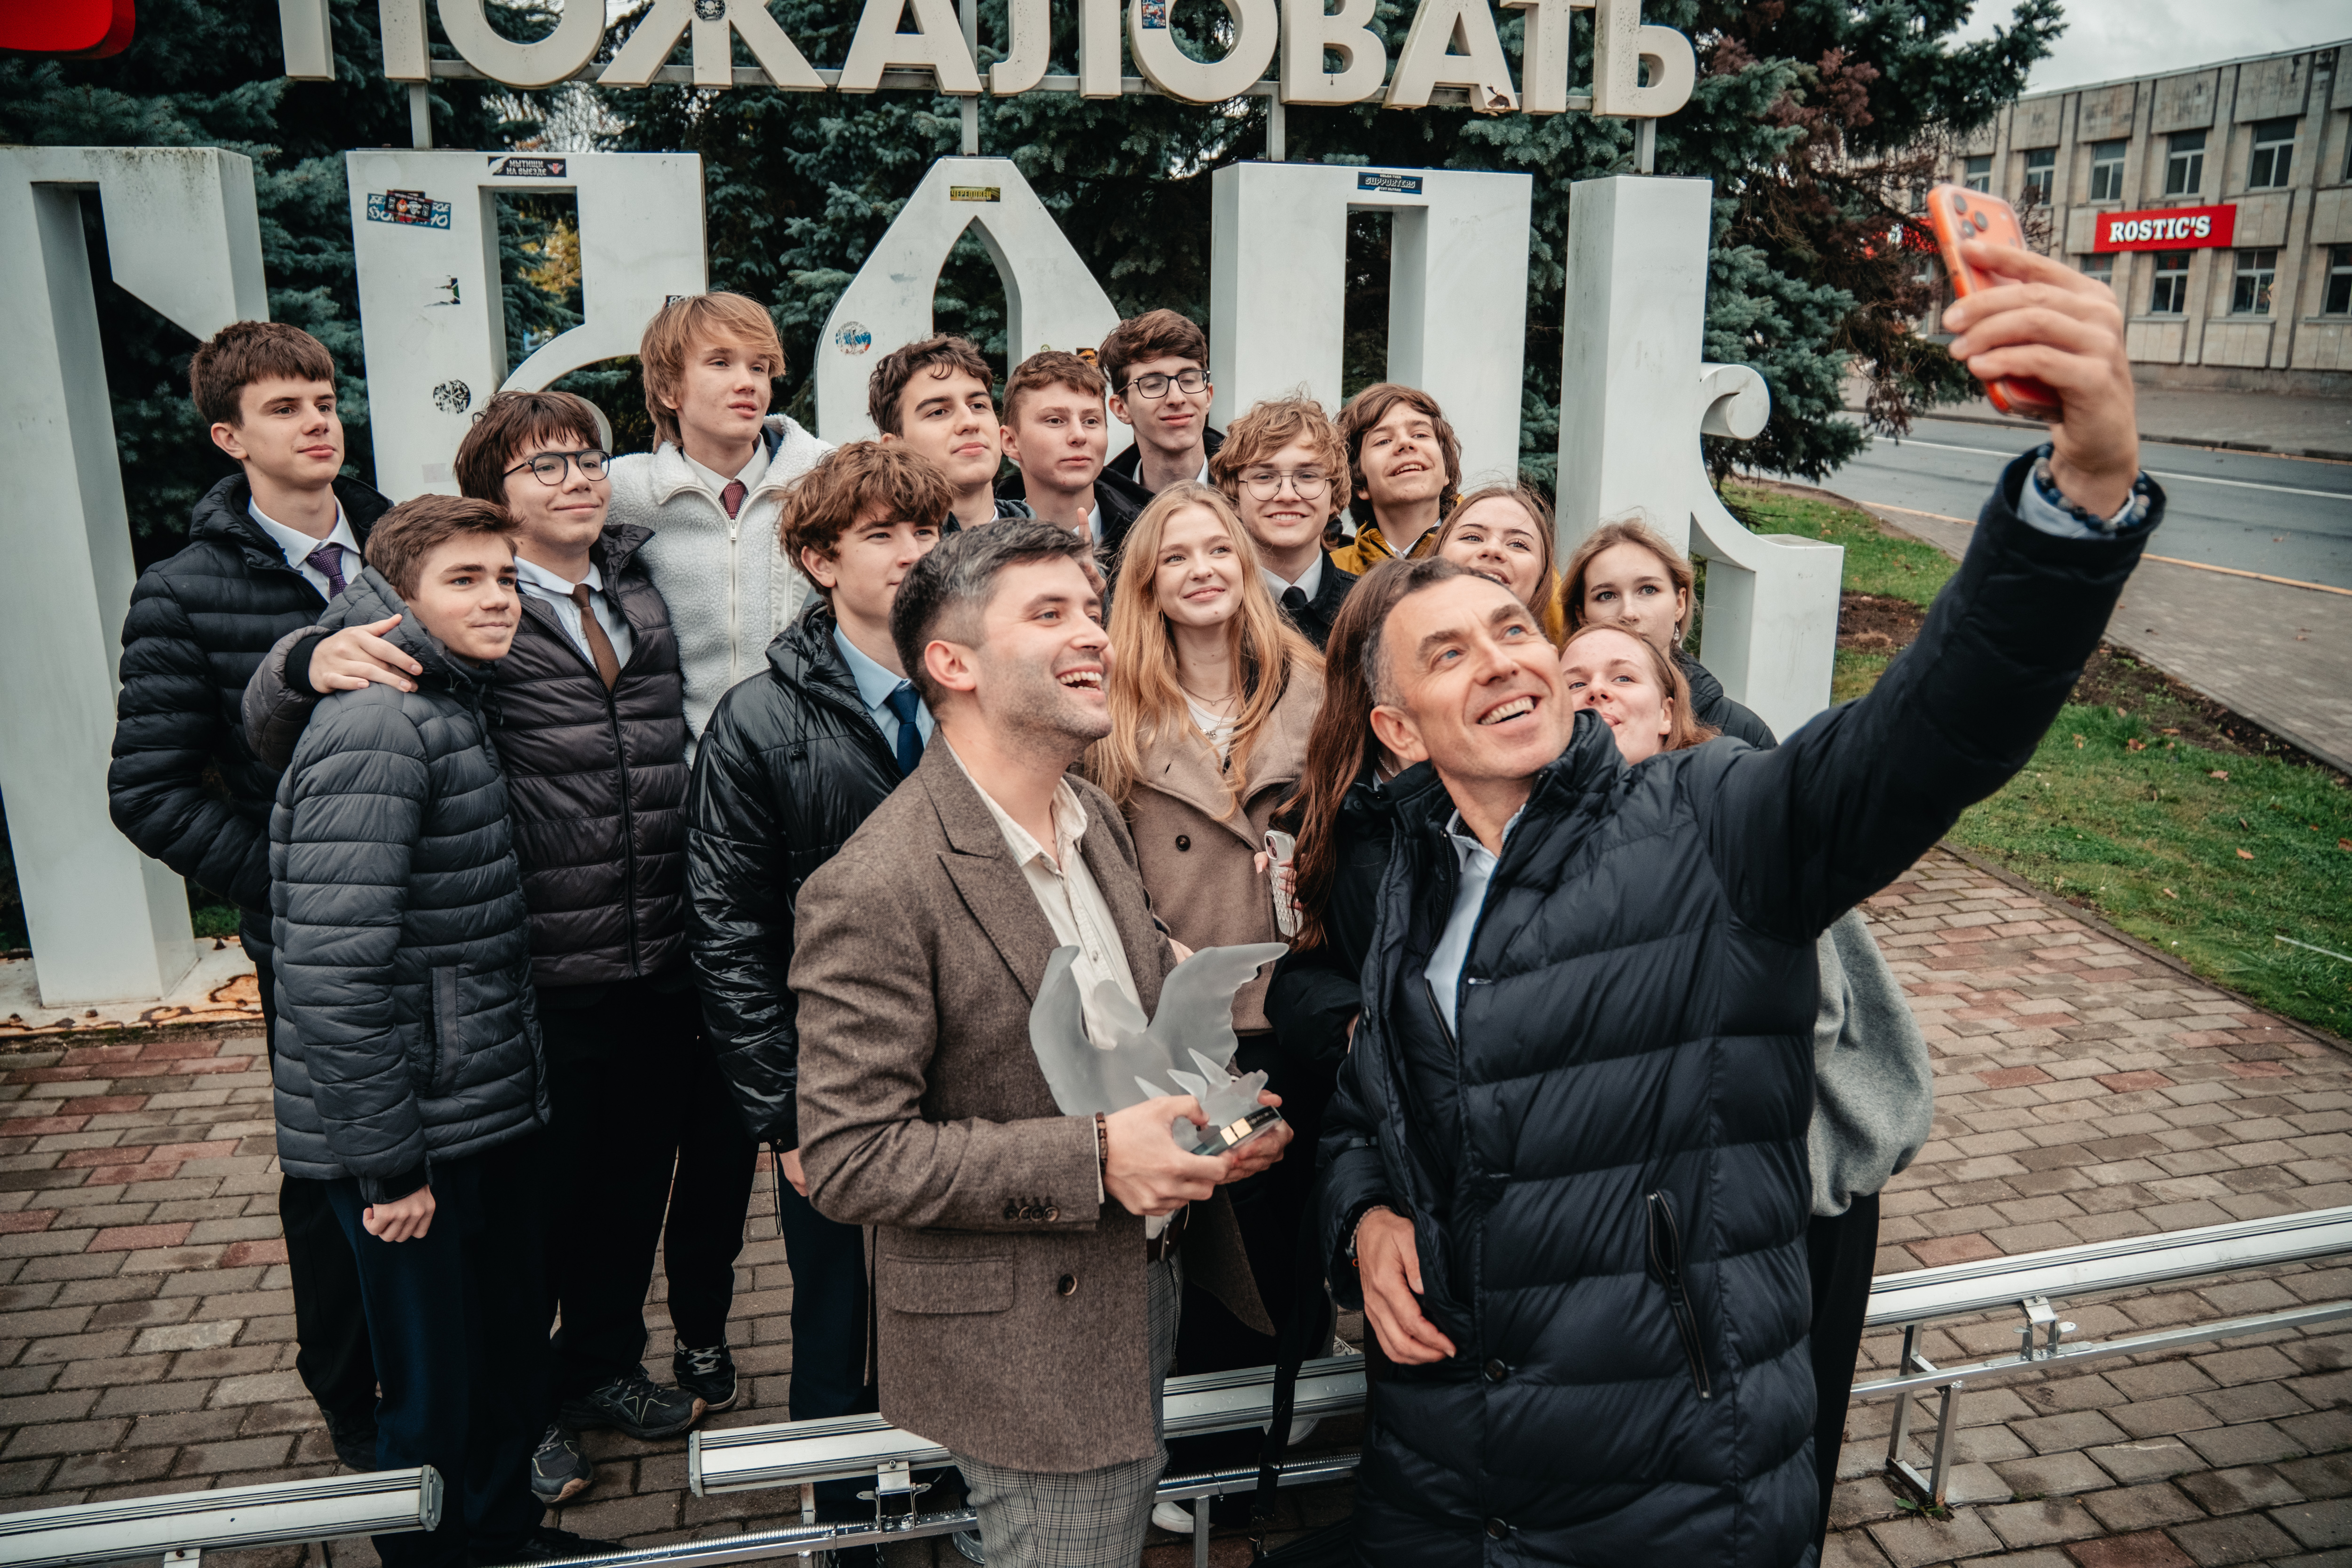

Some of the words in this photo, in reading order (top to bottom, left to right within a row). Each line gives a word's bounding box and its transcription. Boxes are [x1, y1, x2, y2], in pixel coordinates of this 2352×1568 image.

[1365, 177, 1415, 188] SUPPORTERS
[951, 190, 992, 199] ЧЕРЕПОВЕЦ
[2109, 215, 2210, 243] ROSTIC'S
